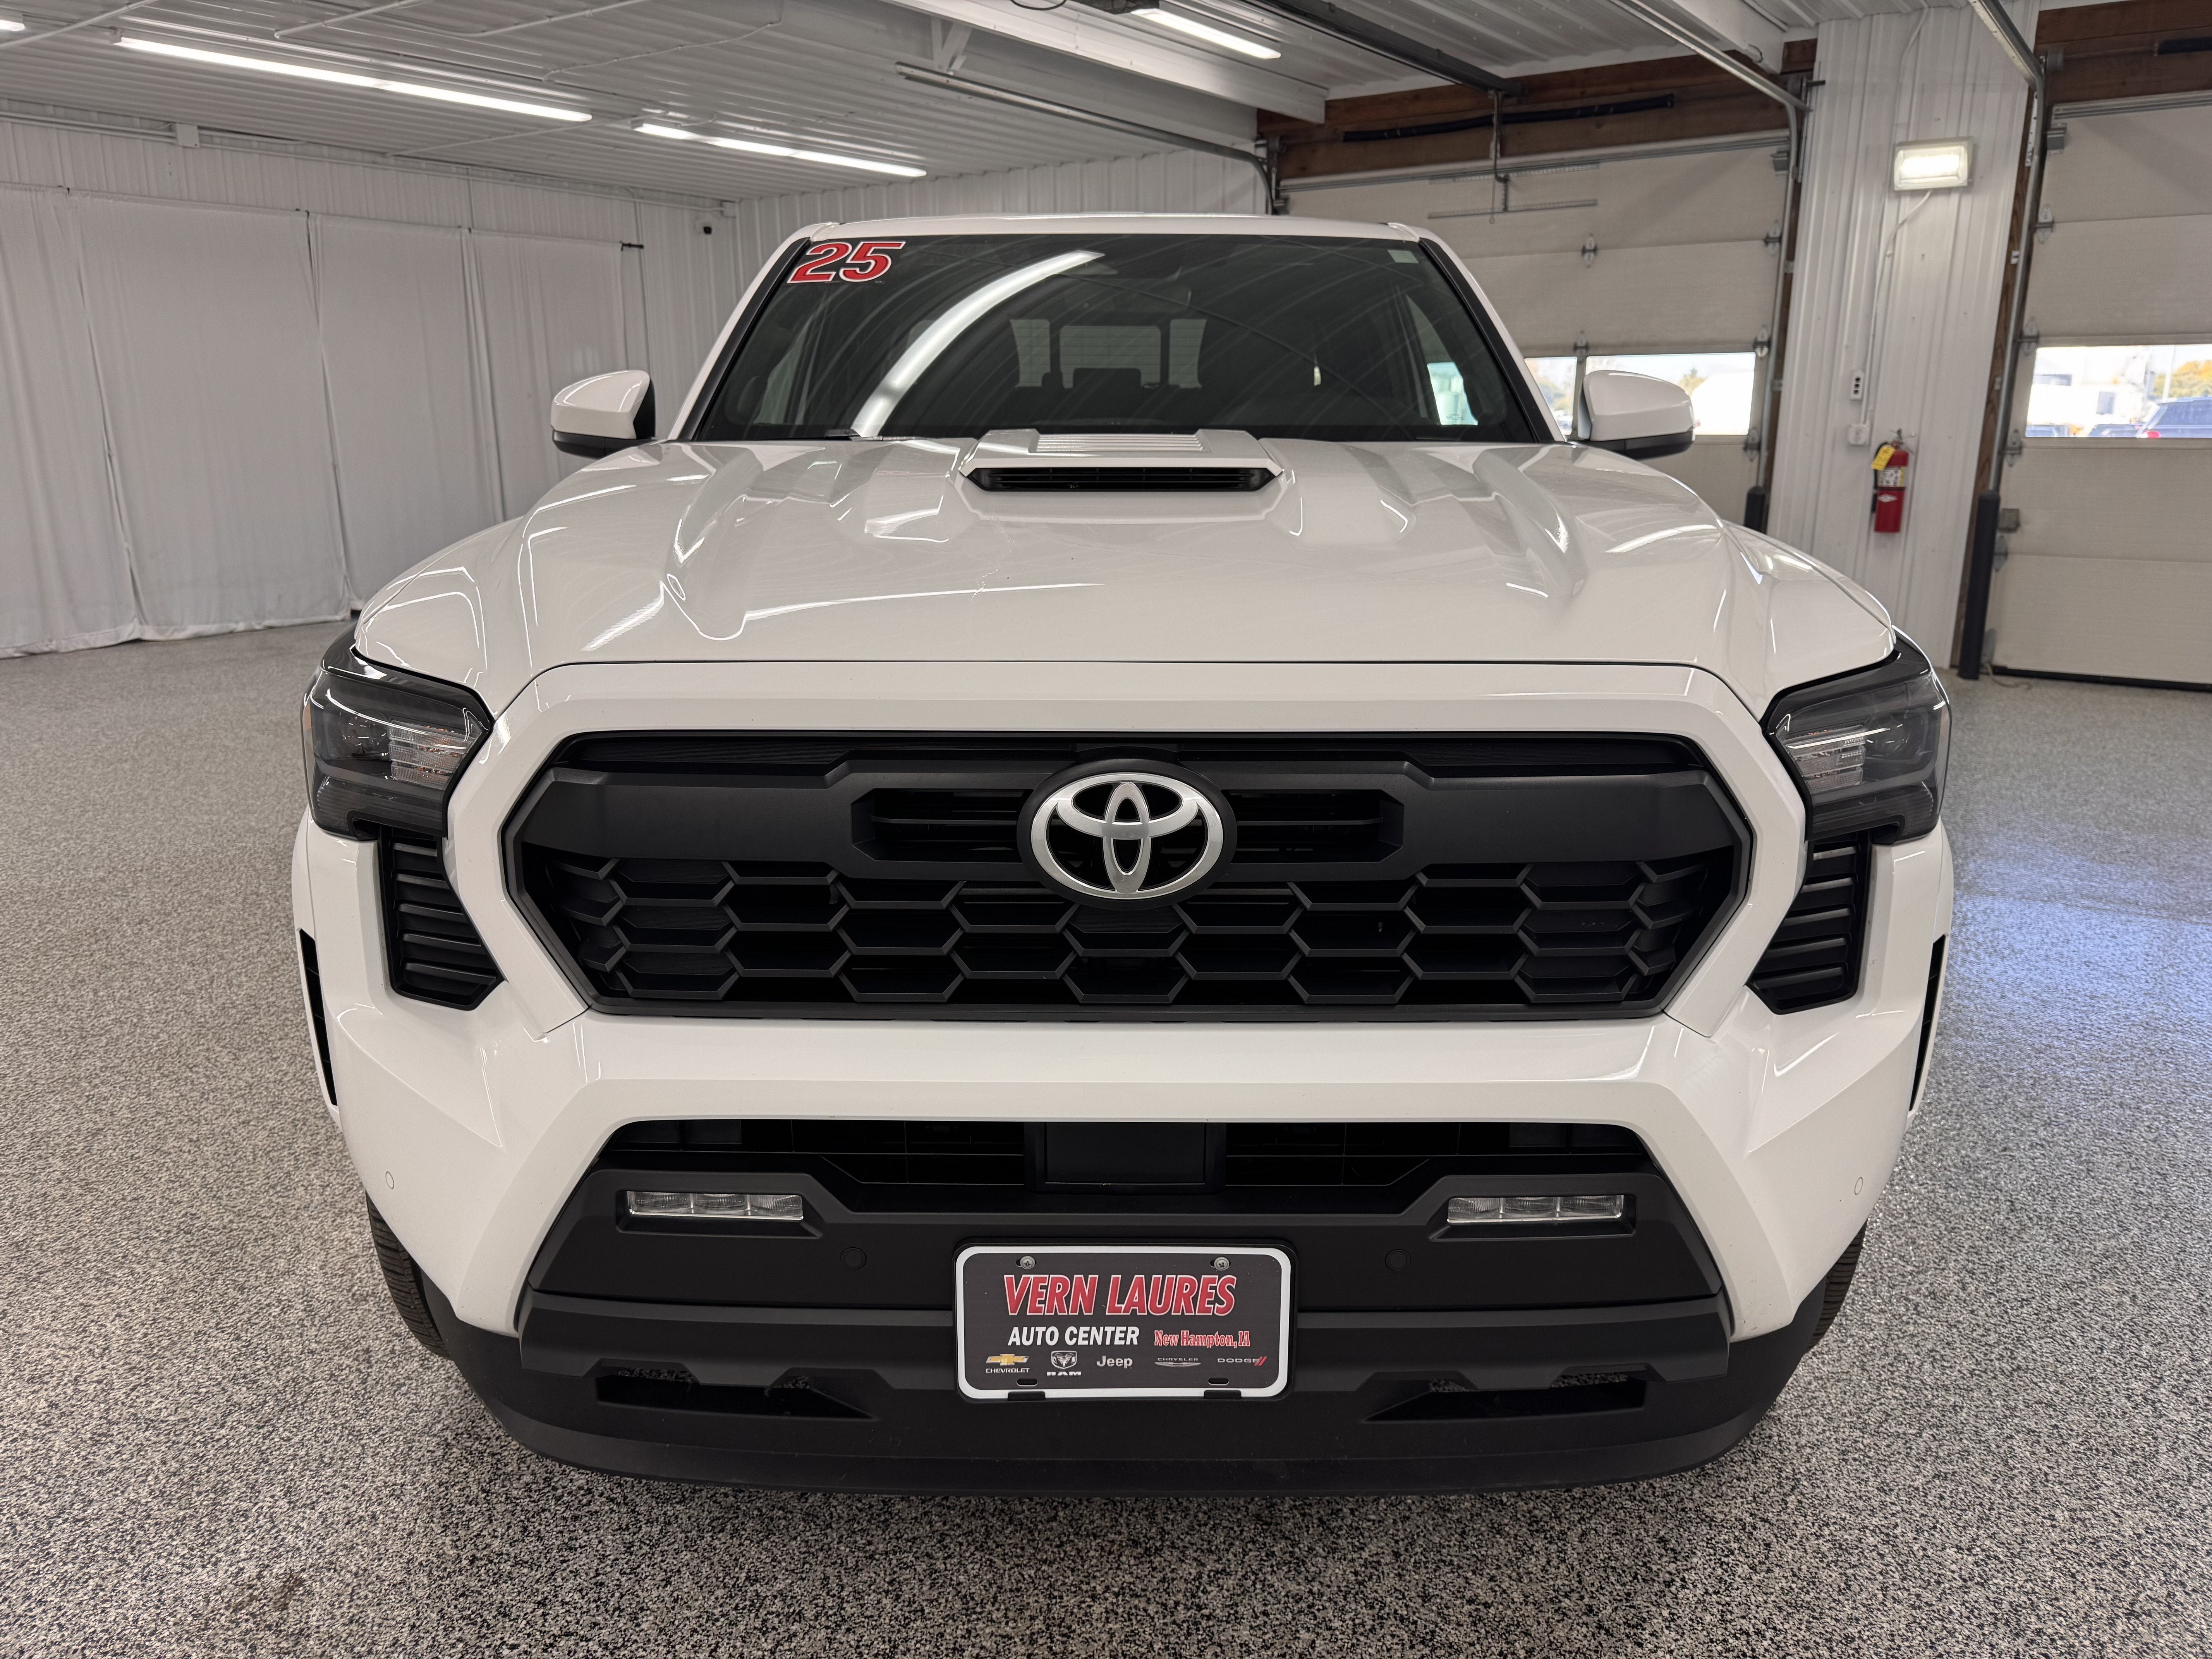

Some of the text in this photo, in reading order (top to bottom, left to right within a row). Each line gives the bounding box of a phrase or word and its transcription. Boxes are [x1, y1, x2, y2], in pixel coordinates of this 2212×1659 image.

[787, 241, 906, 284] 25
[1004, 1274, 1237, 1316] VERN LAURES
[1008, 1326, 1139, 1346] AUTO CENTER
[1154, 1330, 1251, 1348] New Hampton, IA
[1096, 1356, 1133, 1369] Jeep
